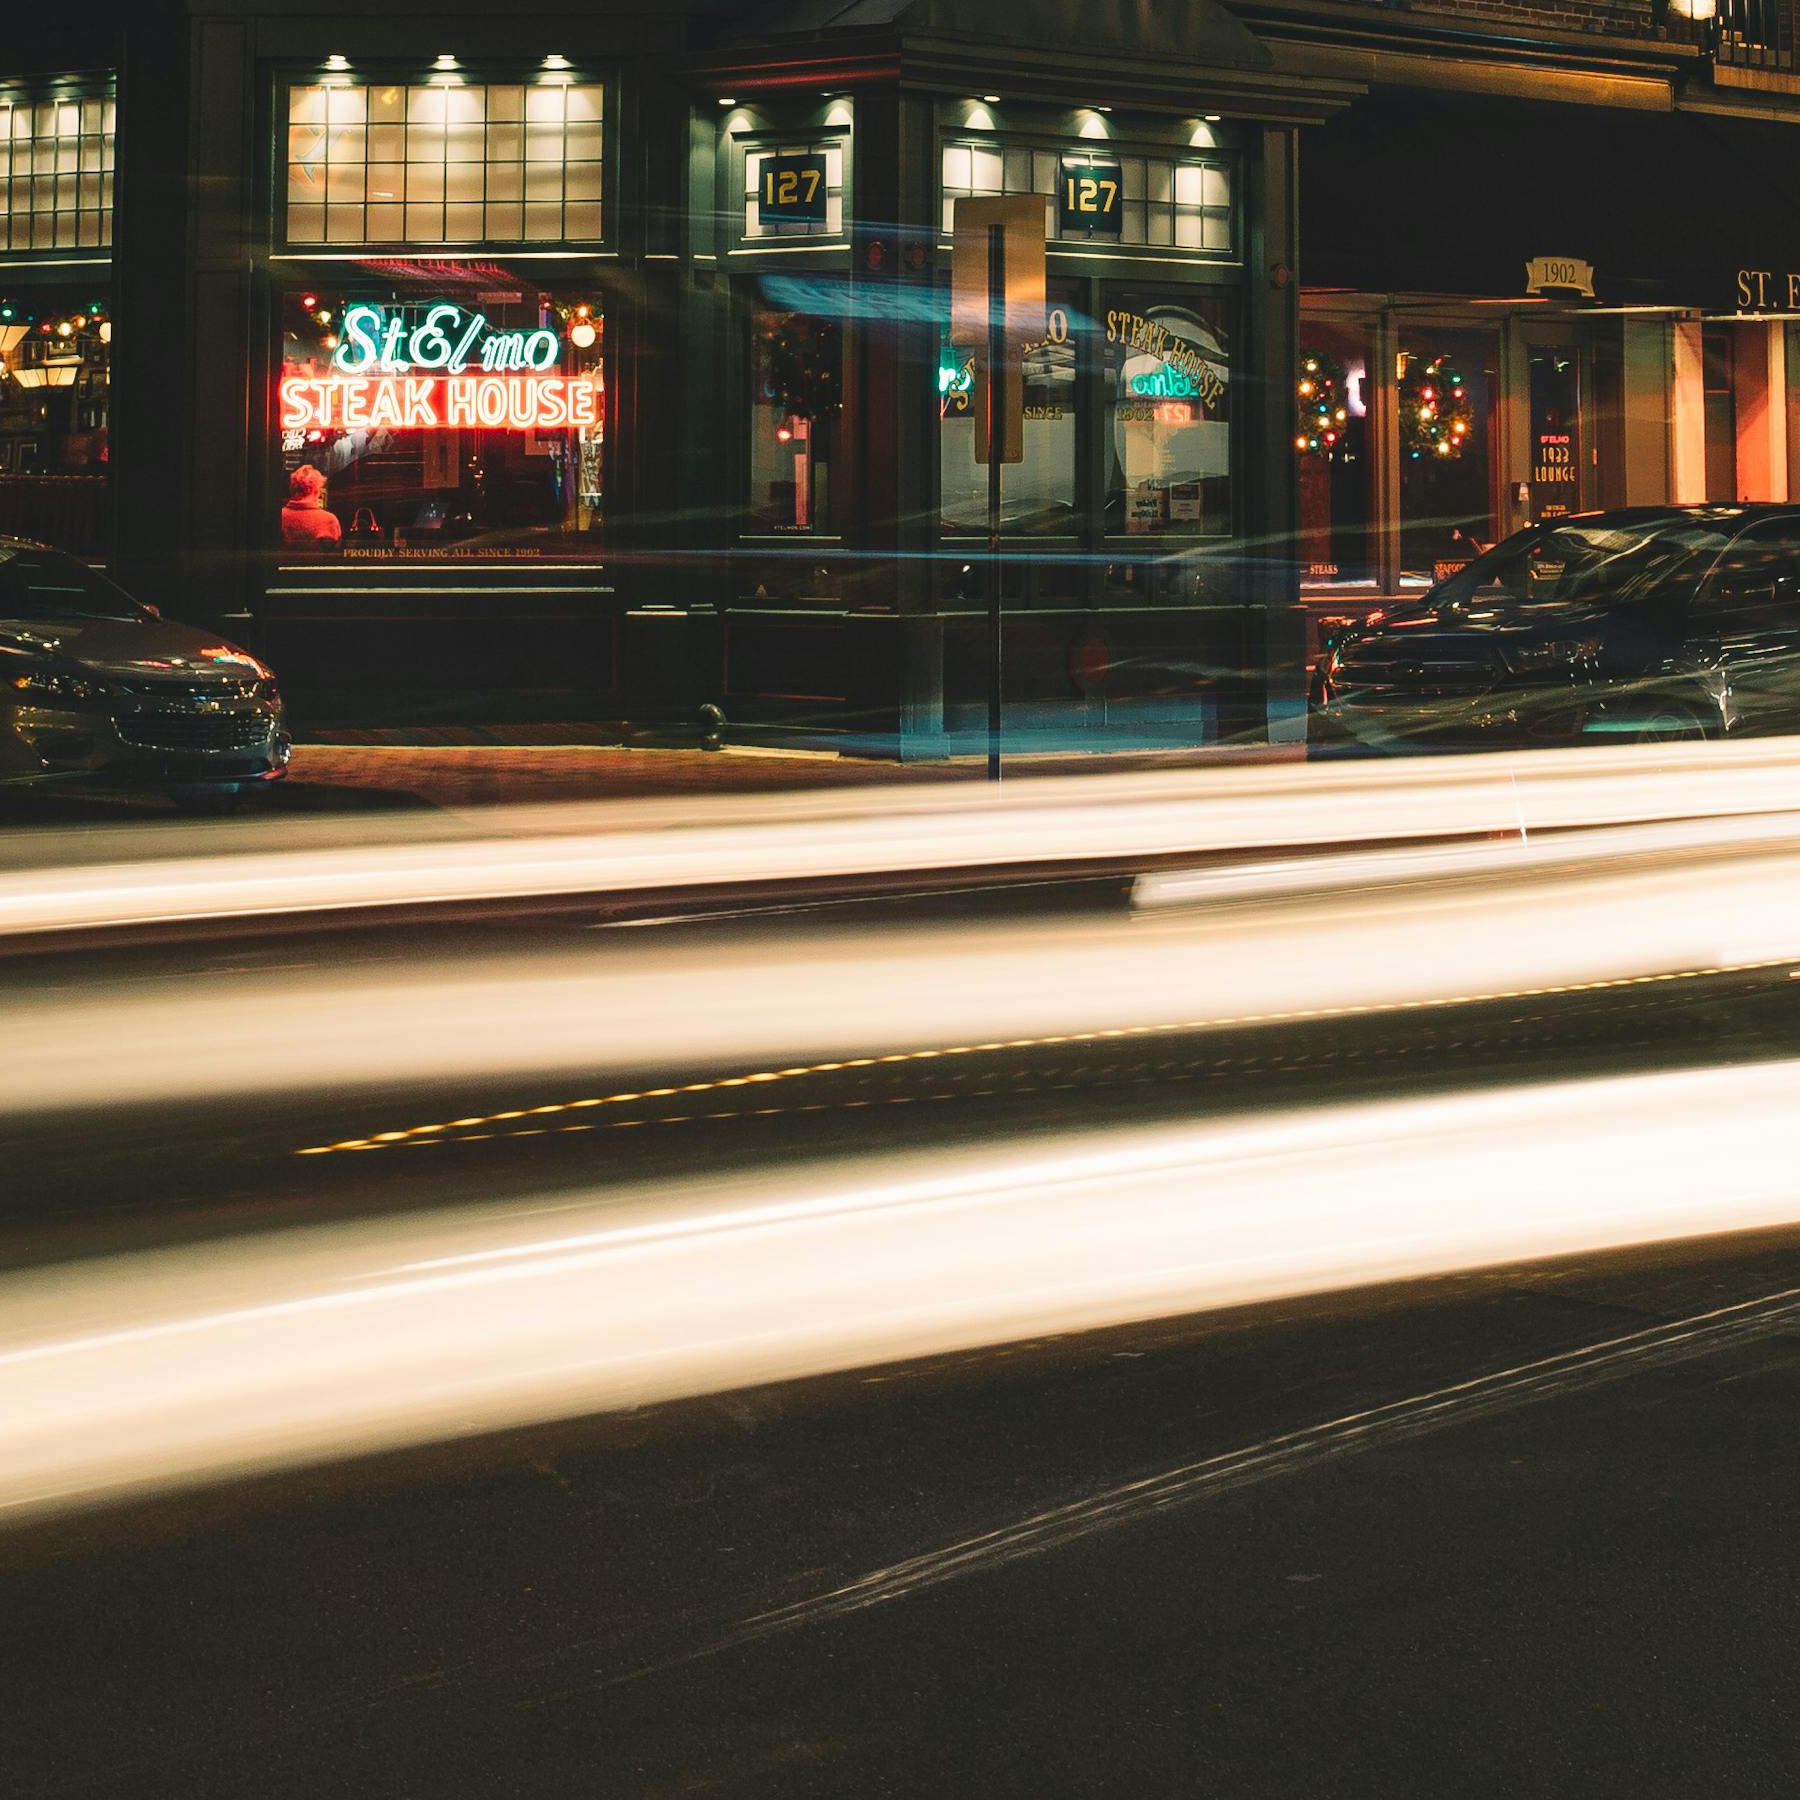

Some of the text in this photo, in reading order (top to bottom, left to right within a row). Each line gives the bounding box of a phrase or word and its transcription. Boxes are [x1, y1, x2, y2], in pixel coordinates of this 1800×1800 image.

[765, 169, 821, 206] 127
[1067, 179, 1117, 213] 127
[1543, 263, 1577, 285] 1902
[1737, 271, 1777, 308] ST.
[409, 304, 560, 375] Elmo
[1106, 309, 1170, 362] STEAK
[1168, 336, 1225, 410] HOUSE
[281, 377, 595, 427] STEAK HOUSE
[1024, 406, 1064, 421] SINCE
[1542, 447, 1569, 463] 1933
[1535, 466, 1576, 482] LOUNGE
[343, 548, 394, 558] PROUDLY
[399, 548, 449, 558] SERVING
[451, 548, 477, 558] ALL
[478, 548, 511, 558] SINCE
[1309, 563, 1338, 575] STEAKS
